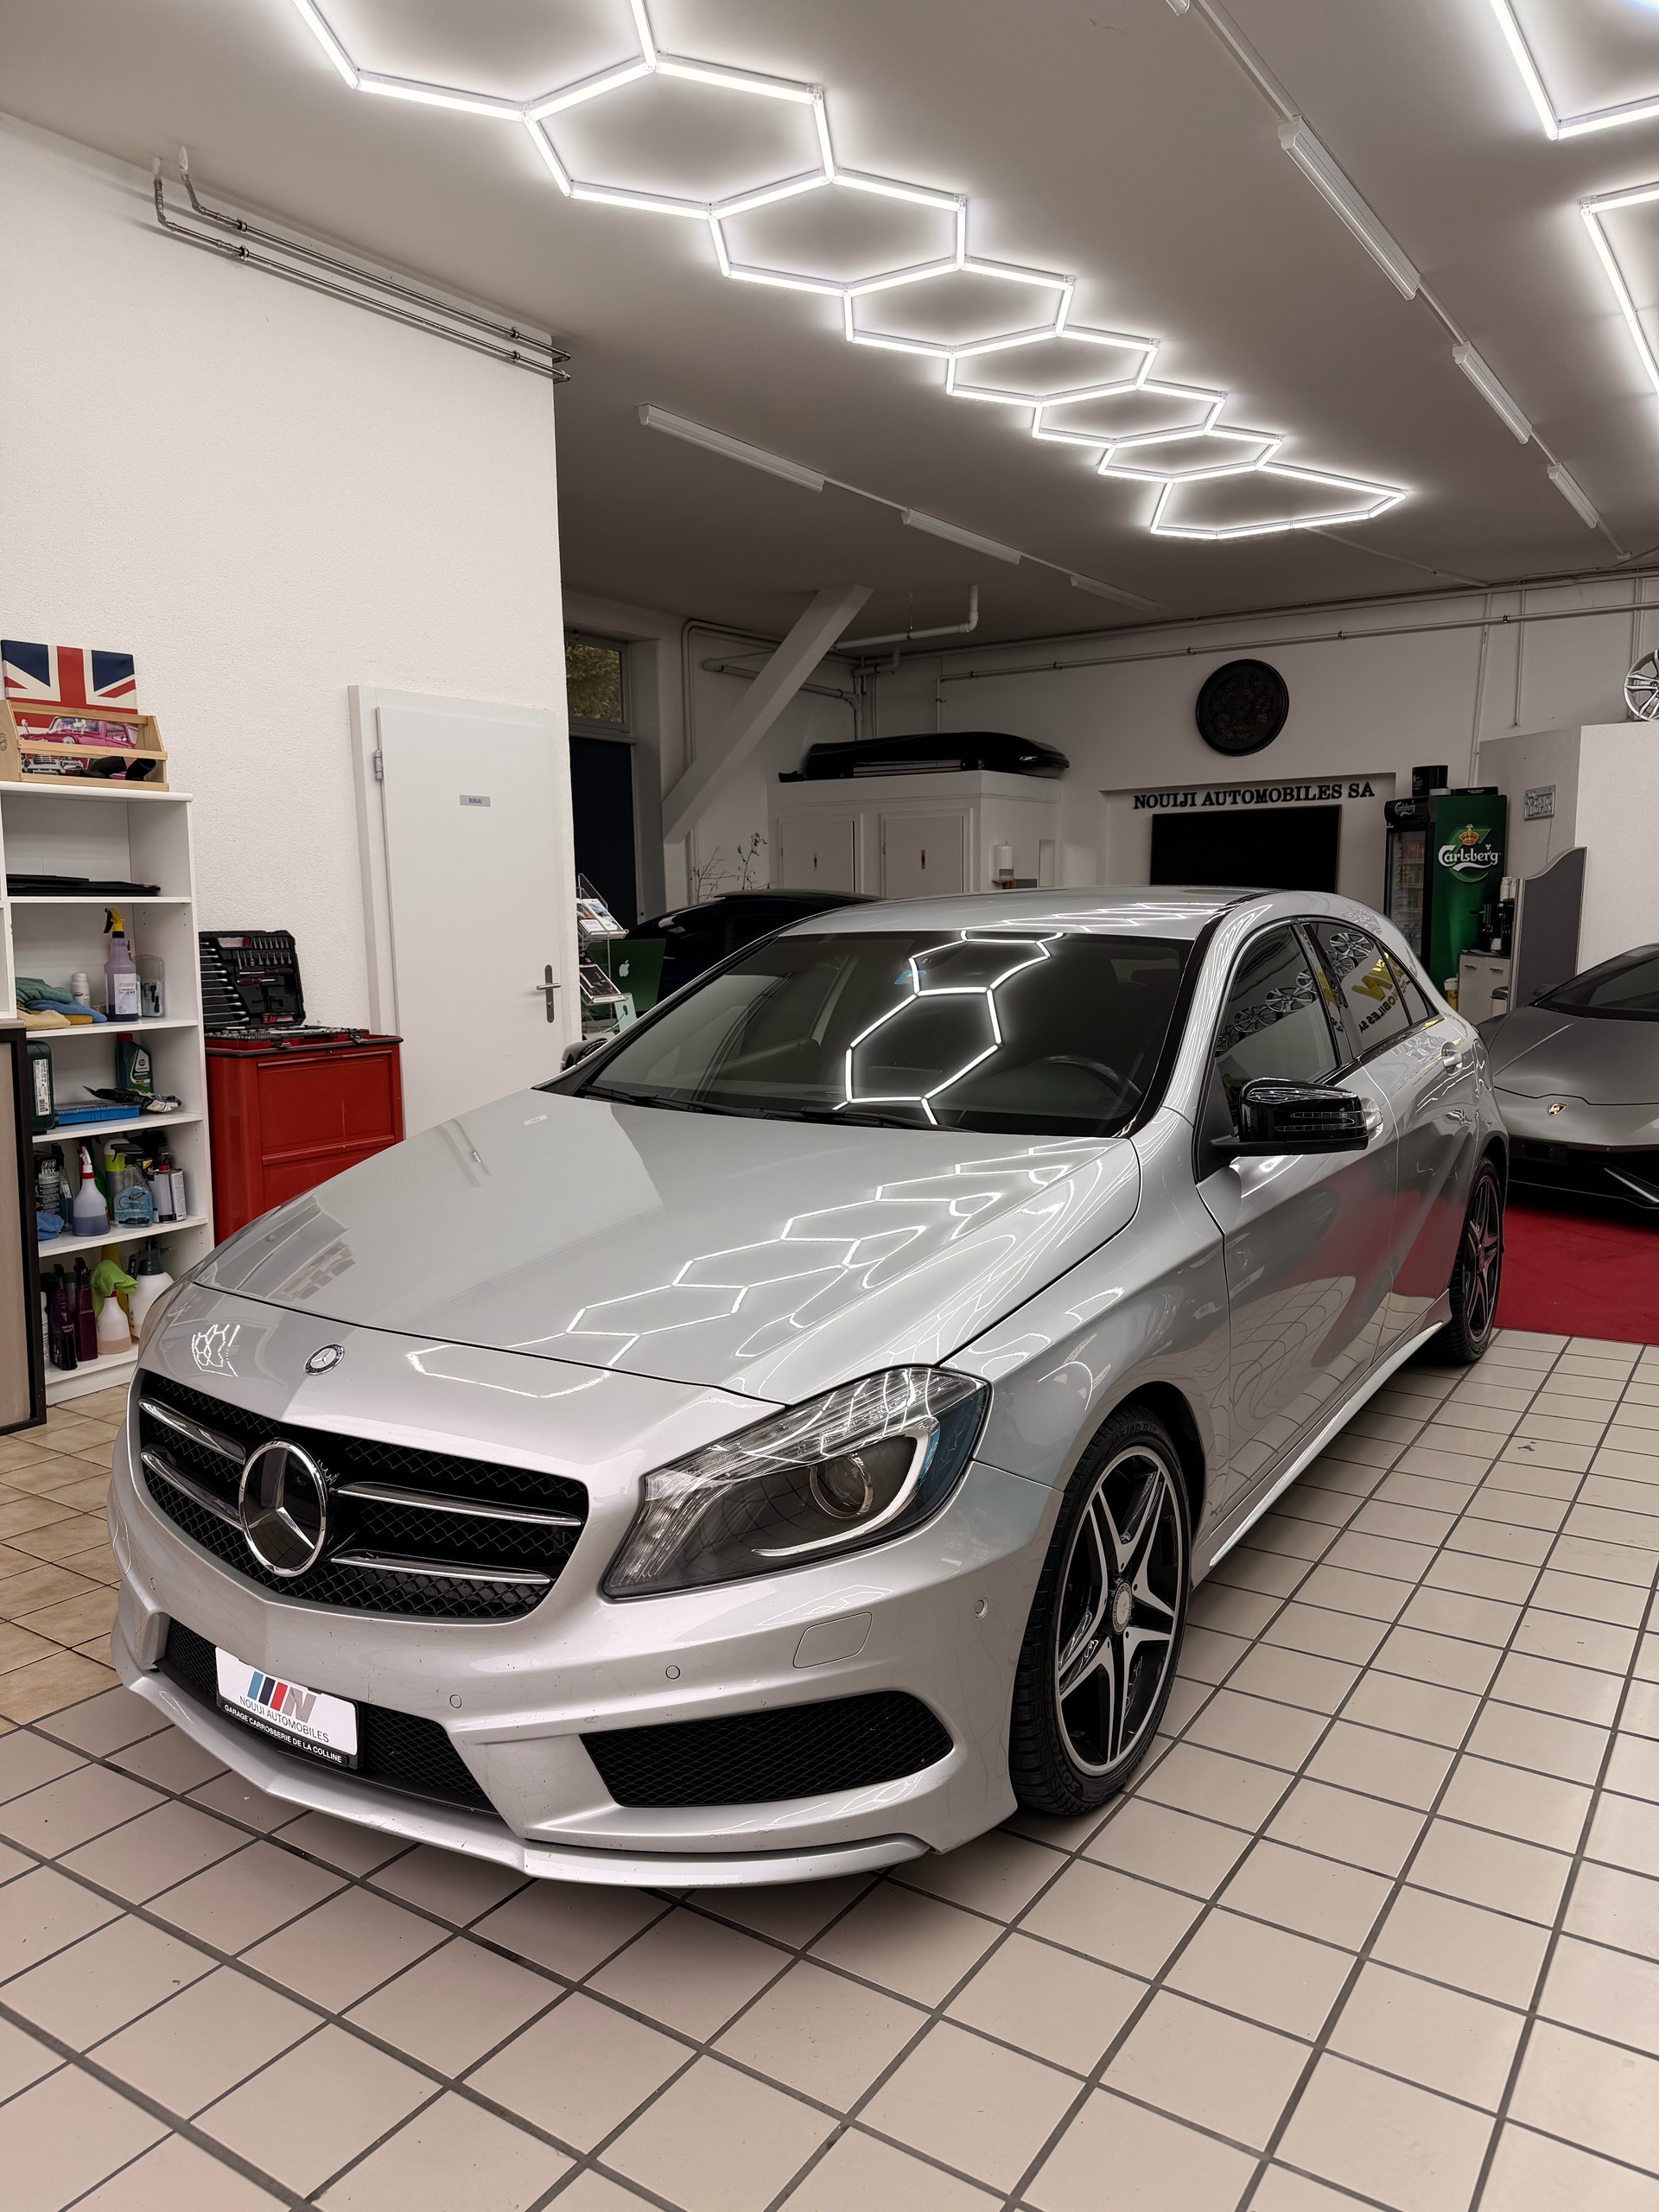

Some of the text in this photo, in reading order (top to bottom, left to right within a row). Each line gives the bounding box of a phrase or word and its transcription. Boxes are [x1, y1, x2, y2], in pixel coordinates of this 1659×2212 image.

[1134, 782, 1375, 809] NOUIJI AUTOMOBILES SA
[1395, 800, 1416, 817] Carlsberg
[1438, 844, 1499, 871] Carlsberg
[225, 1705, 342, 1763] GARAGE CARROSSERIE DE LA COLLINE
[267, 1710, 329, 1743] AUTOMOBILES
